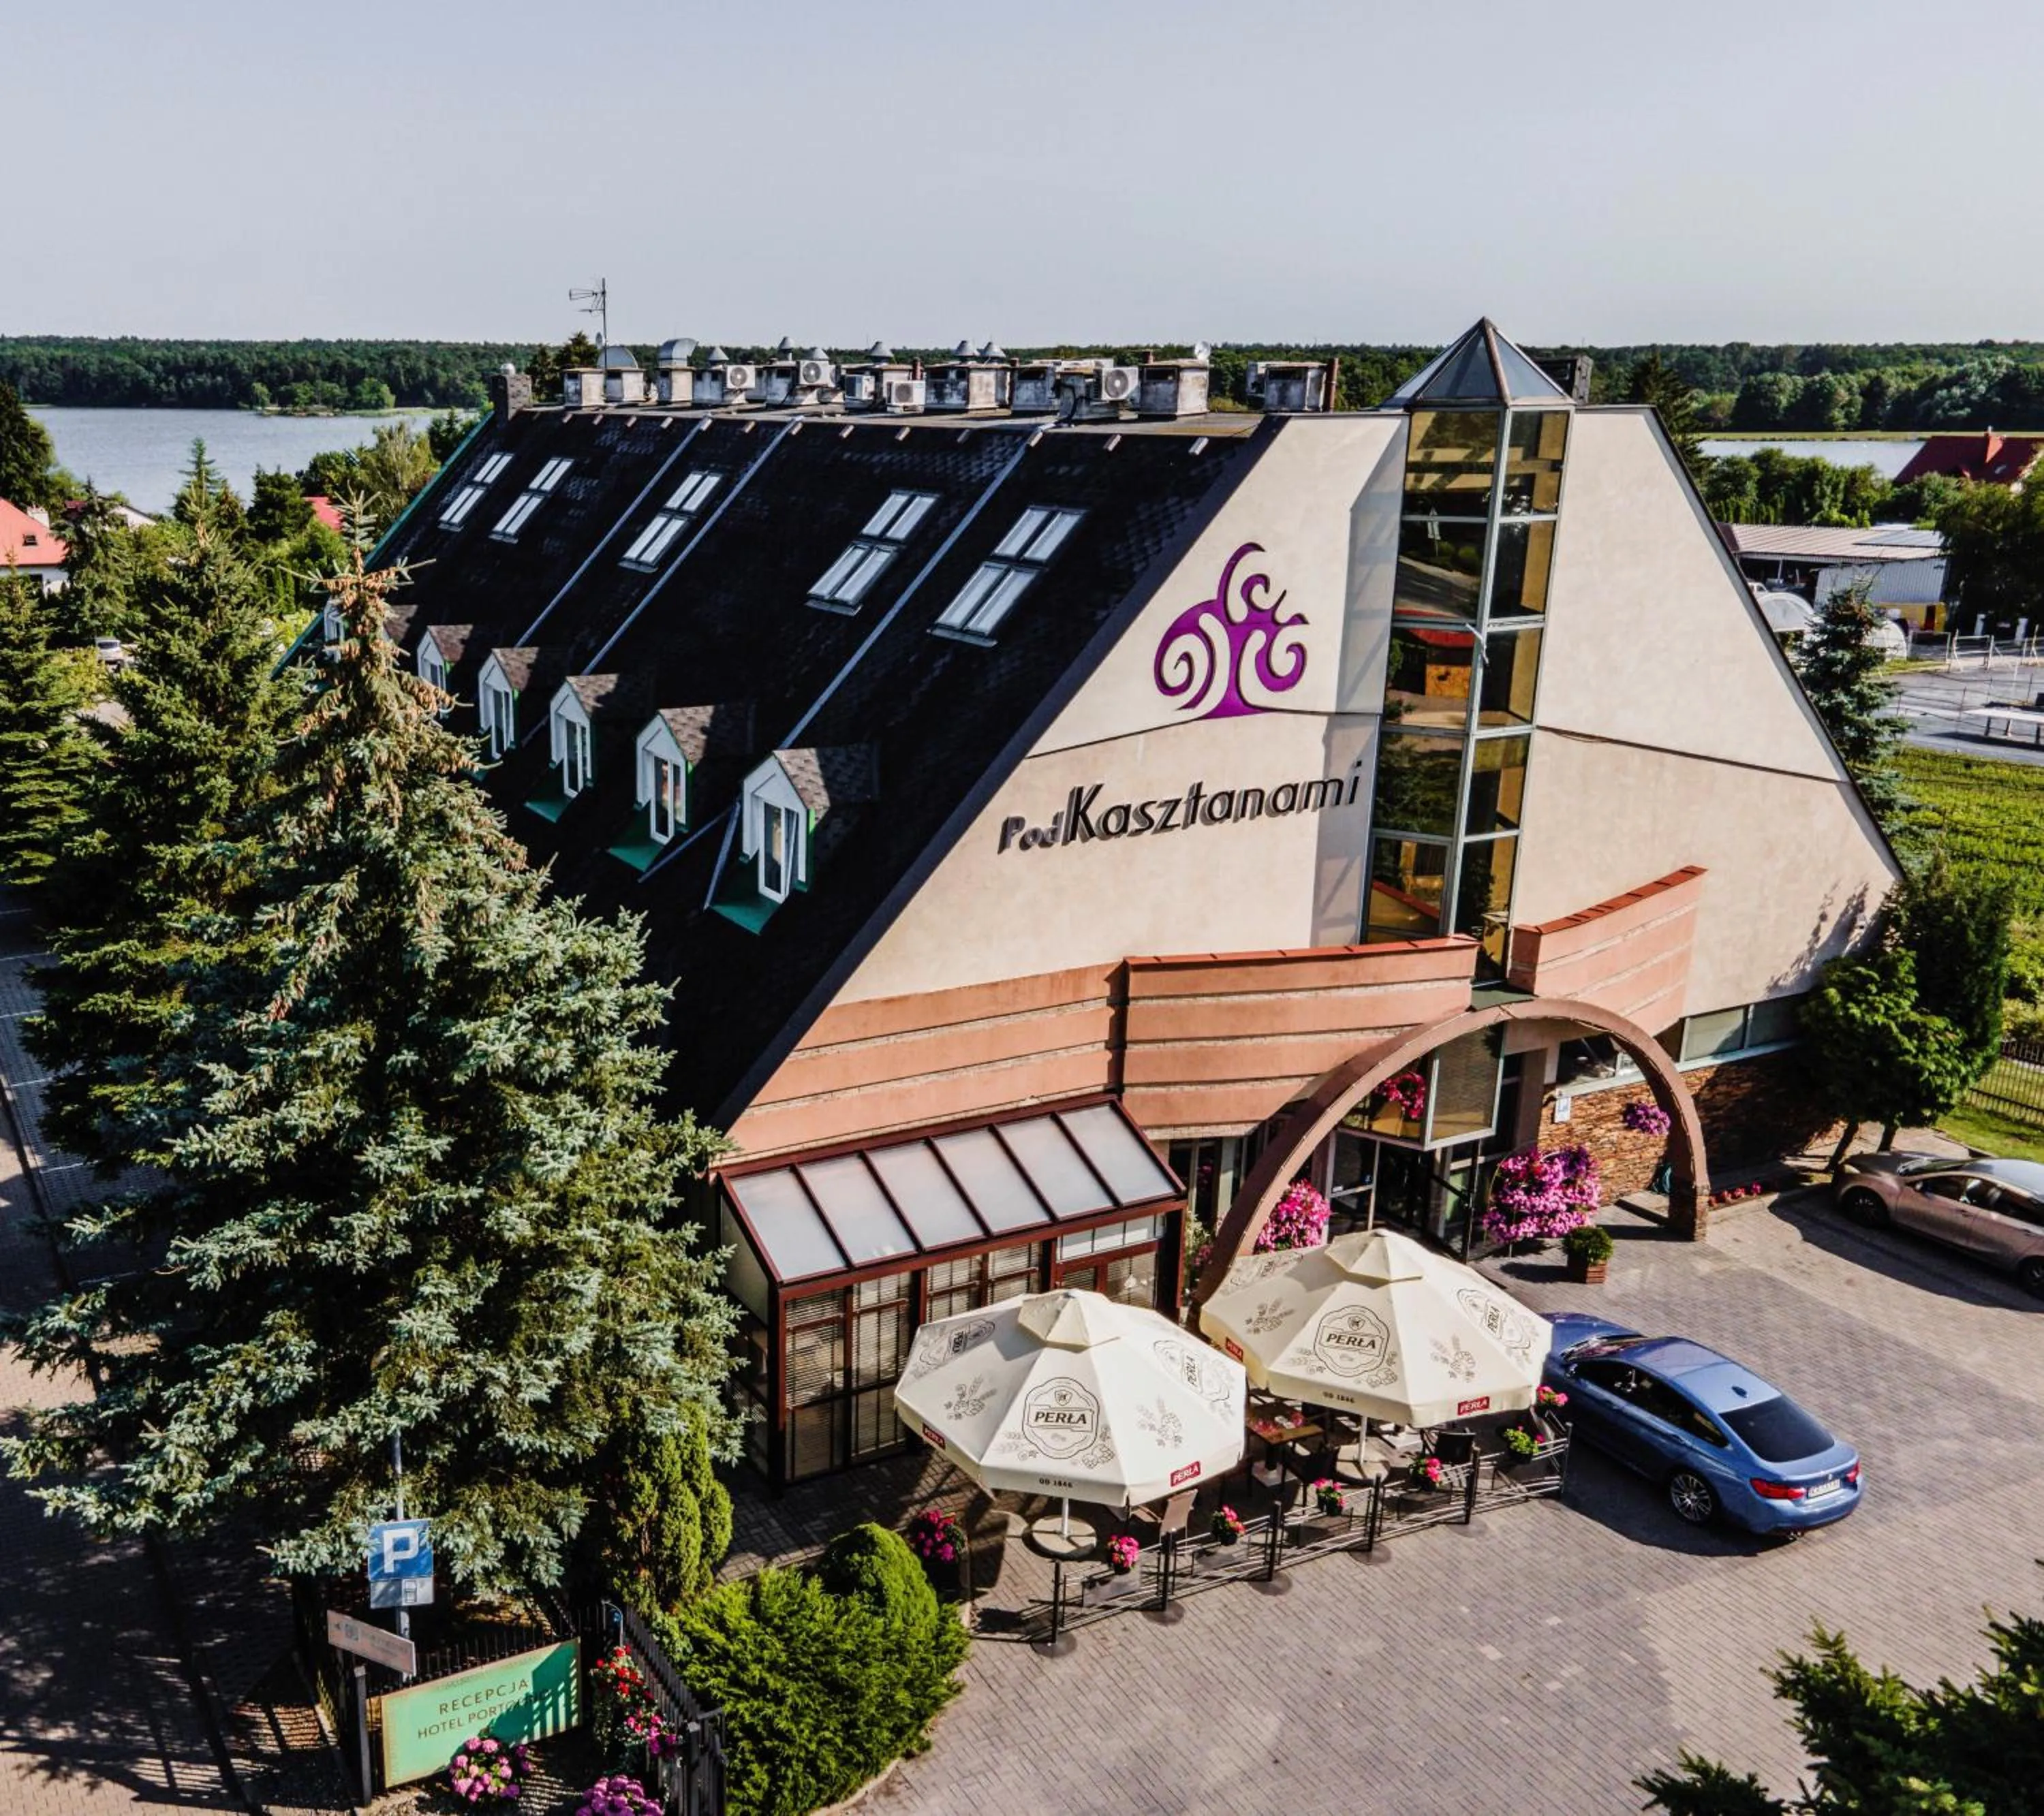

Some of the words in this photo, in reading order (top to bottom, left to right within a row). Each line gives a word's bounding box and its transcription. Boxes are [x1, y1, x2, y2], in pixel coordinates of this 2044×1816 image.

[1326, 1333, 1376, 1349] PERŁA
[1459, 1400, 1487, 1413] PERŁA
[1034, 1411, 1087, 1424] PERŁA
[384, 1528, 418, 1573] P
[439, 1678, 528, 1715] RECEPCJA
[418, 1718, 462, 1738] HOTEL
